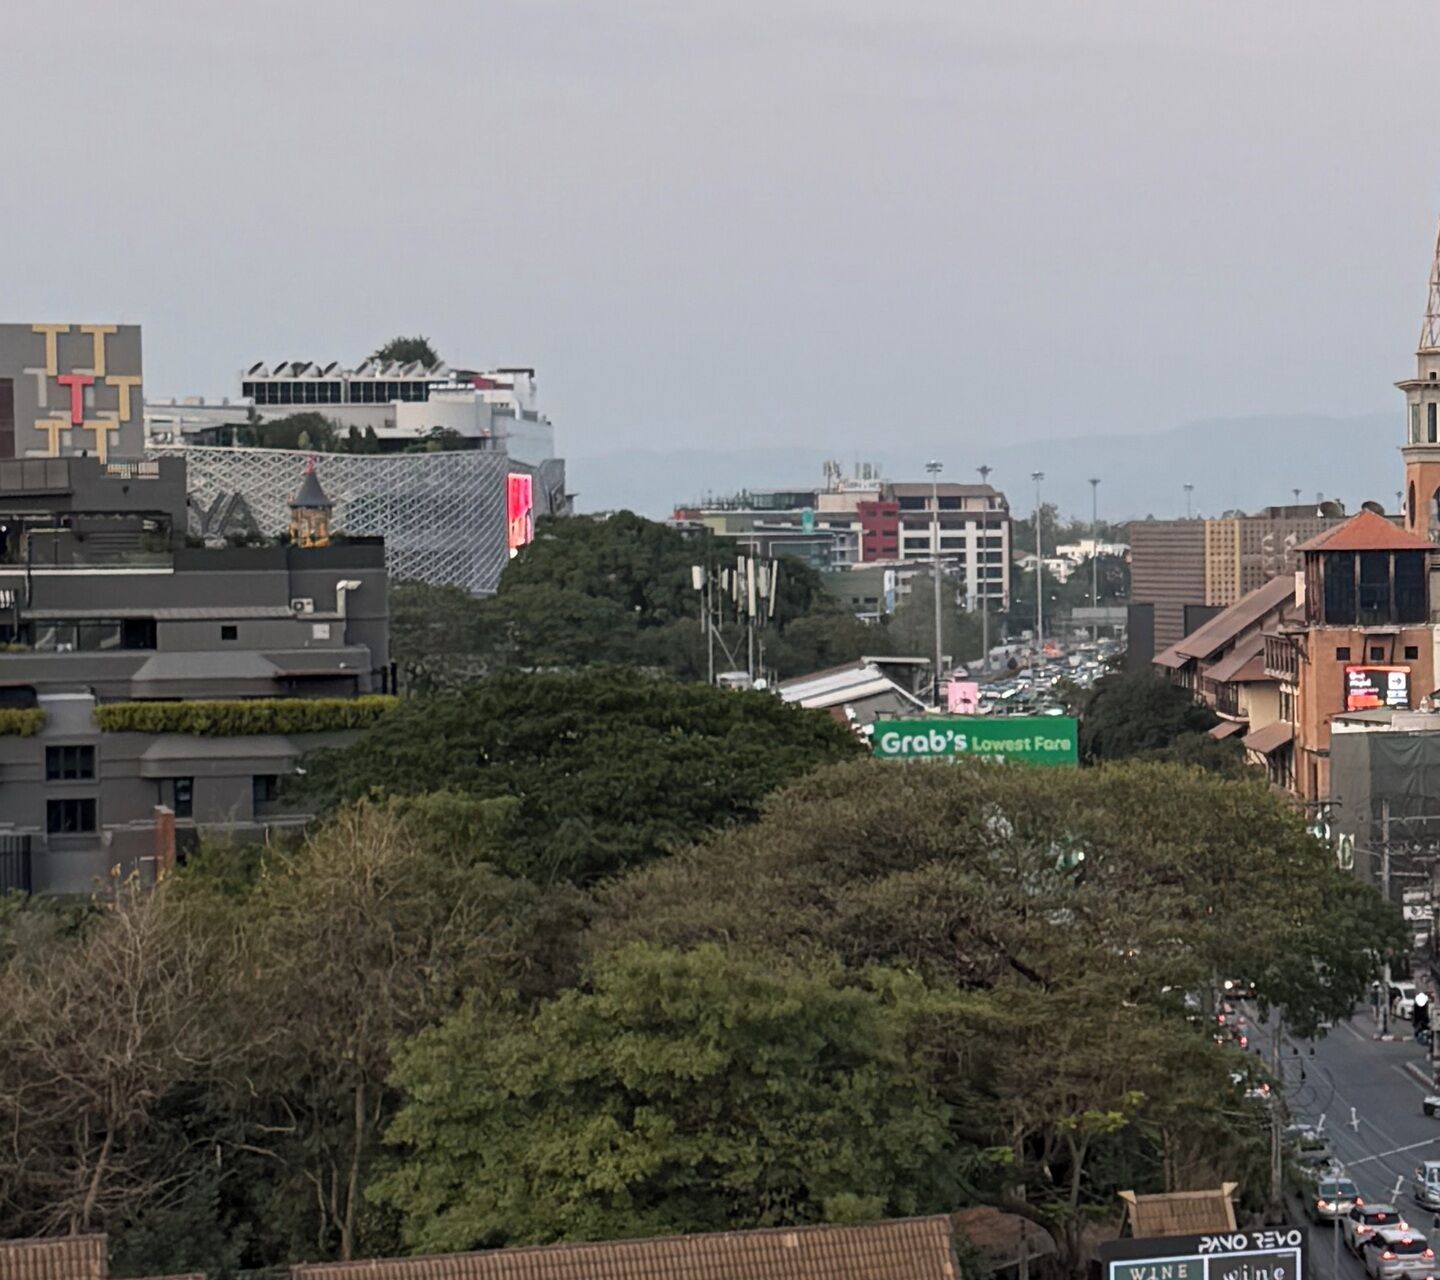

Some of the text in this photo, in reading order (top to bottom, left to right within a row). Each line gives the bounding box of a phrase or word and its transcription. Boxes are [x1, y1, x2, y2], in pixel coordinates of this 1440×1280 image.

[881, 729, 1071, 753] Grab's Lowest Fare
[1252, 1229, 1302, 1249] REVO
[1130, 1264, 1188, 1280] WINE
